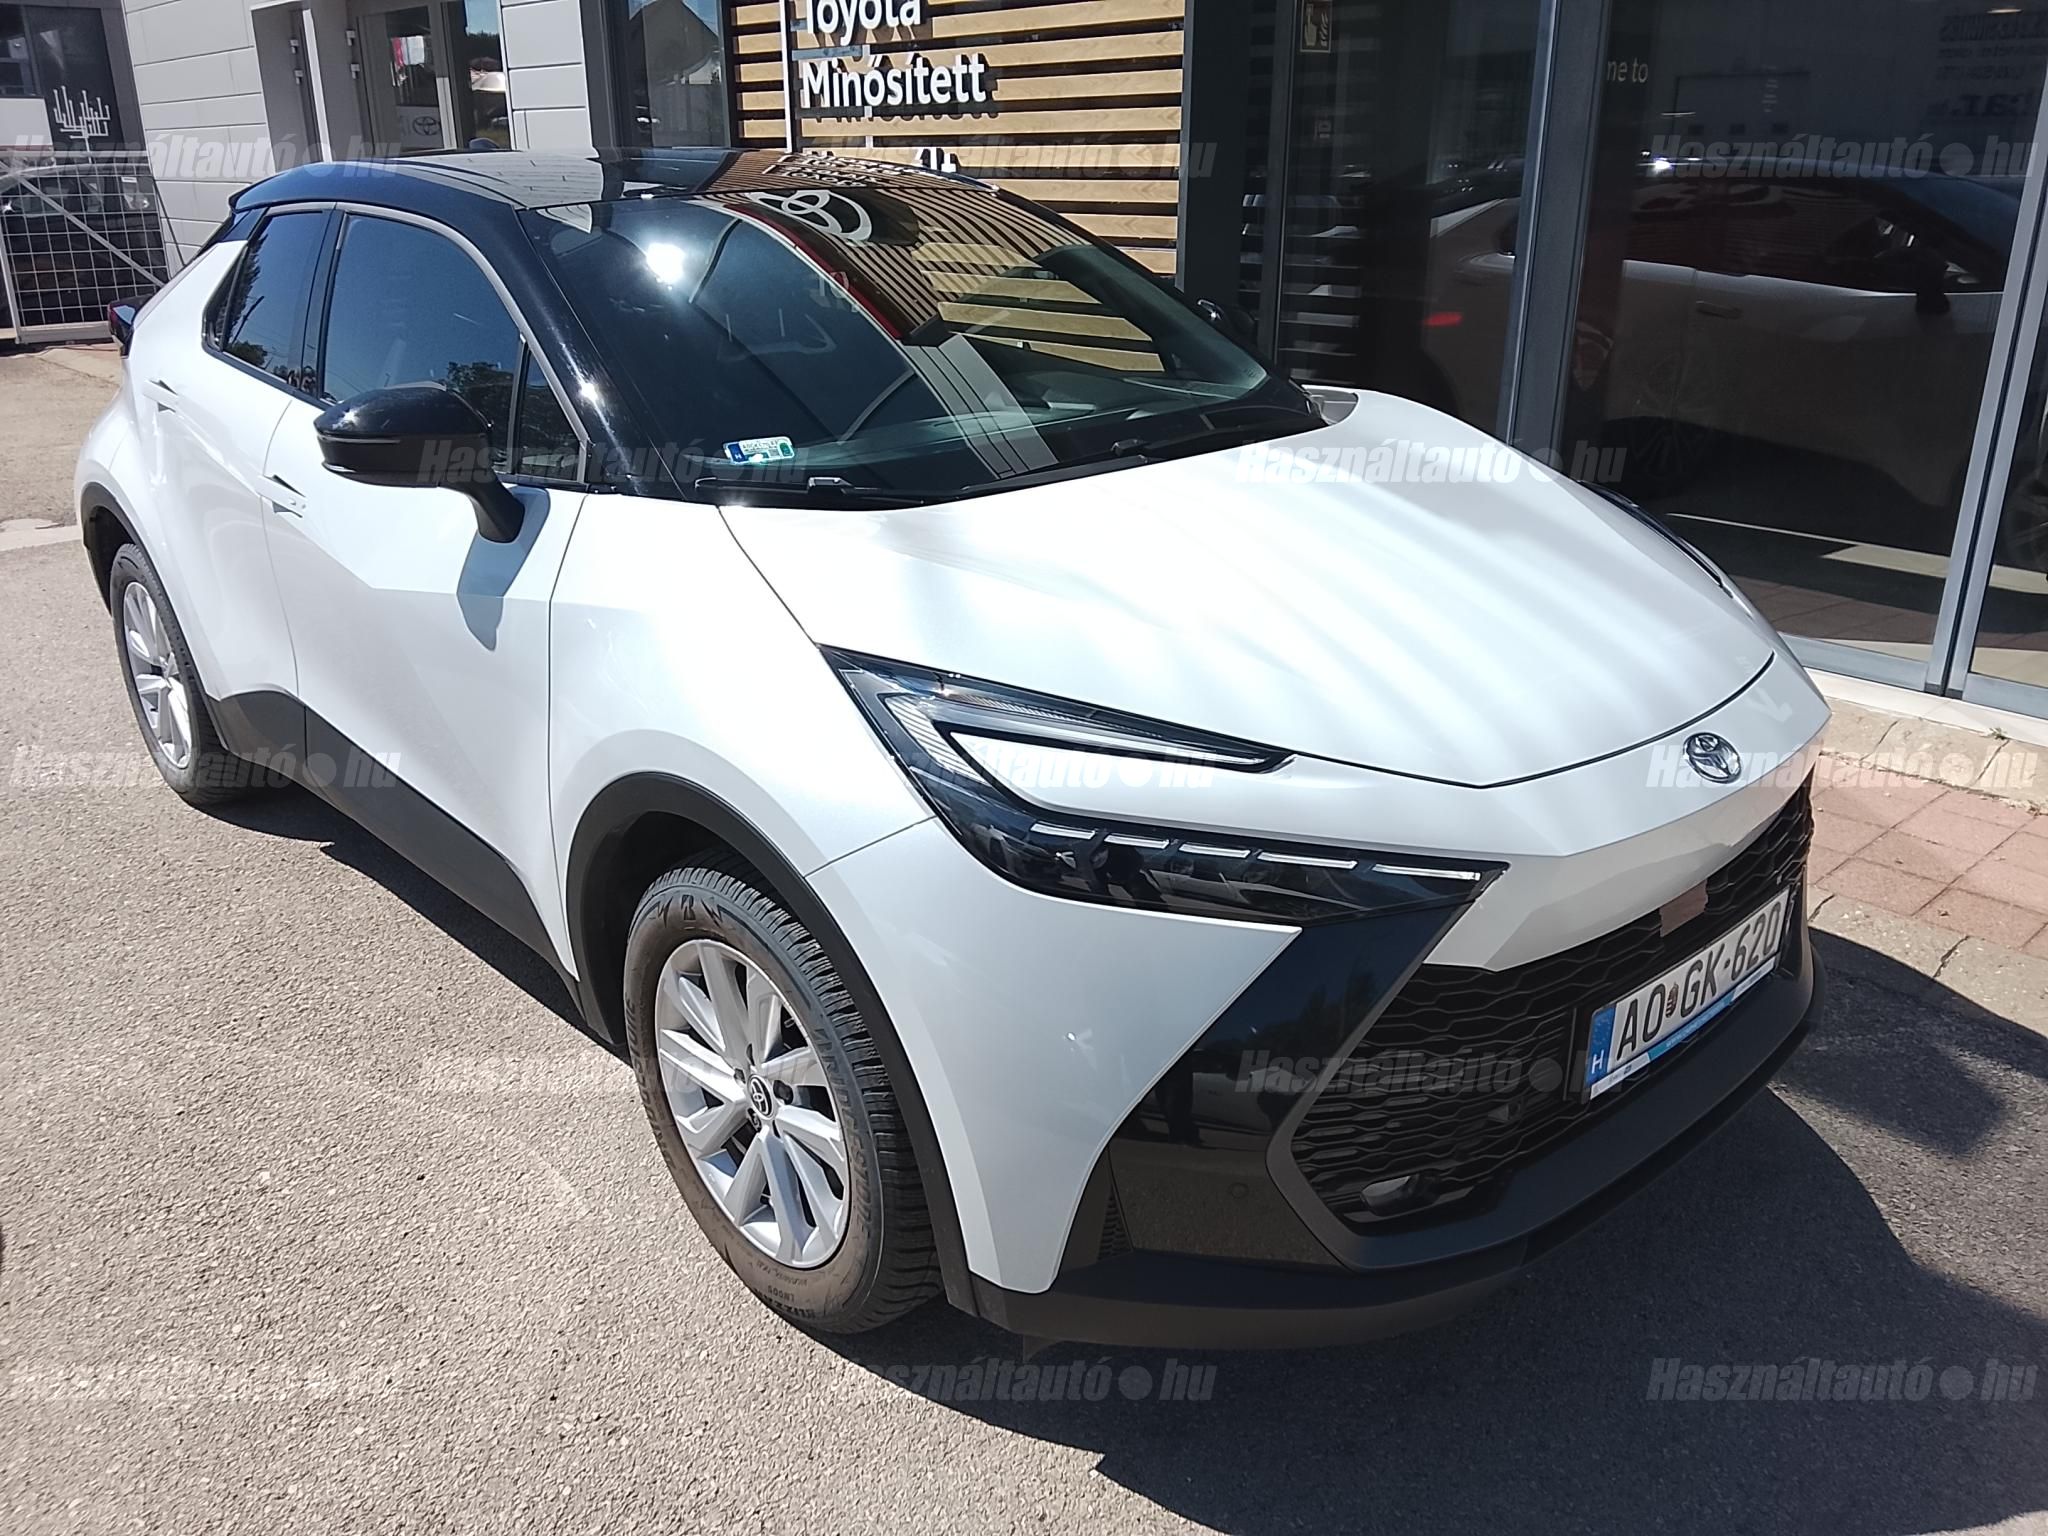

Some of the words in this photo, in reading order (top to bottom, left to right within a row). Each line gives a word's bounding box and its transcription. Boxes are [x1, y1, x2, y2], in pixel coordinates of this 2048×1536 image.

[803, 53, 987, 109] Minősített
[1632, 57, 1649, 83] to
[1616, 982, 1665, 1061] AO
[1591, 1049, 1604, 1074] H
